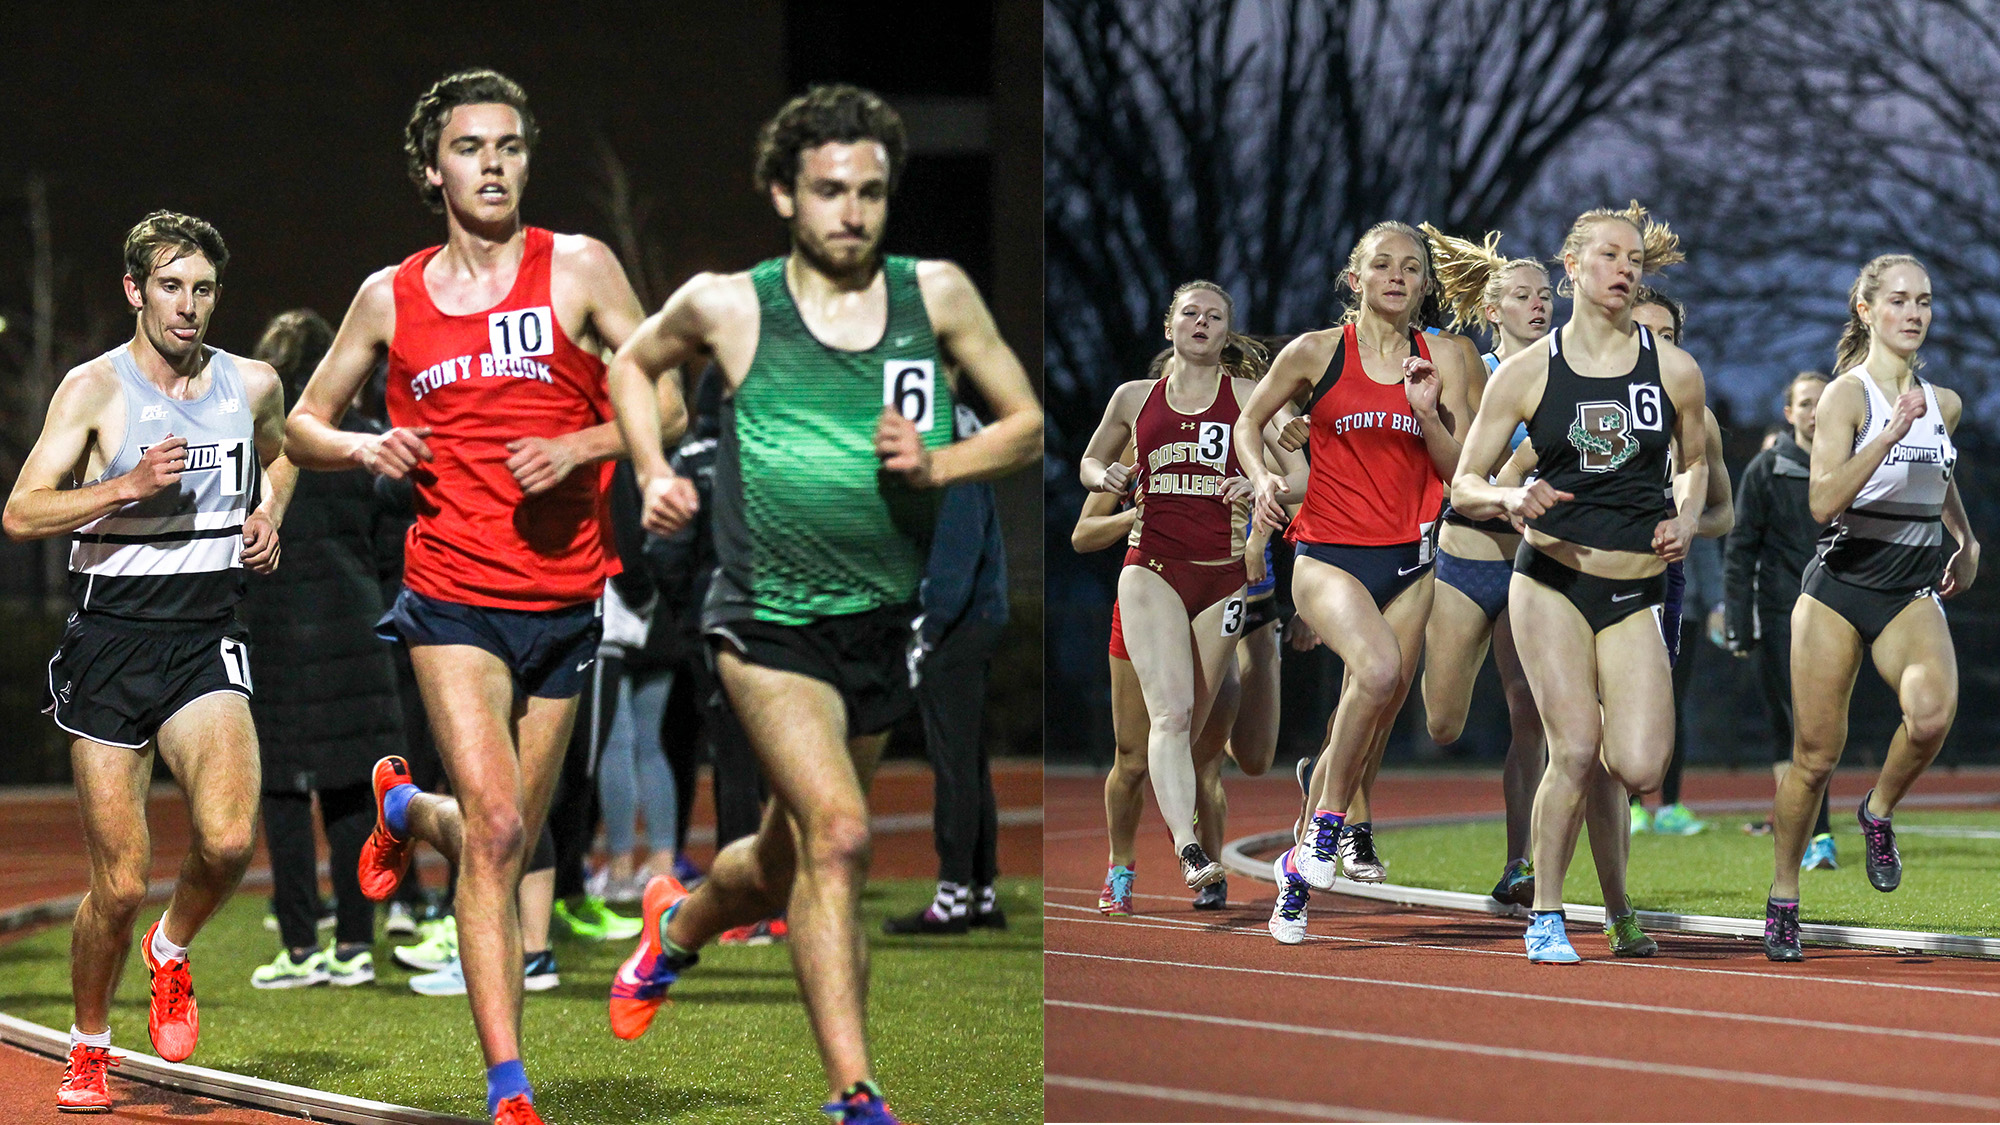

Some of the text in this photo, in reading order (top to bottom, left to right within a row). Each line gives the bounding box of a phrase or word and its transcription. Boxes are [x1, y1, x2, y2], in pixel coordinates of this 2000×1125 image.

[495, 311, 542, 355] 10
[410, 353, 554, 402] STONY BROOK
[894, 367, 926, 423] 6
[1335, 411, 1423, 438] STONY BRO
[1635, 388, 1658, 426] 6
[1148, 441, 1226, 476] BOST
[1201, 424, 1224, 460] 3
[226, 442, 244, 492] 1
[1148, 473, 1226, 496] COLLEGE
[1225, 600, 1243, 634] 3
[225, 643, 245, 685] 1
